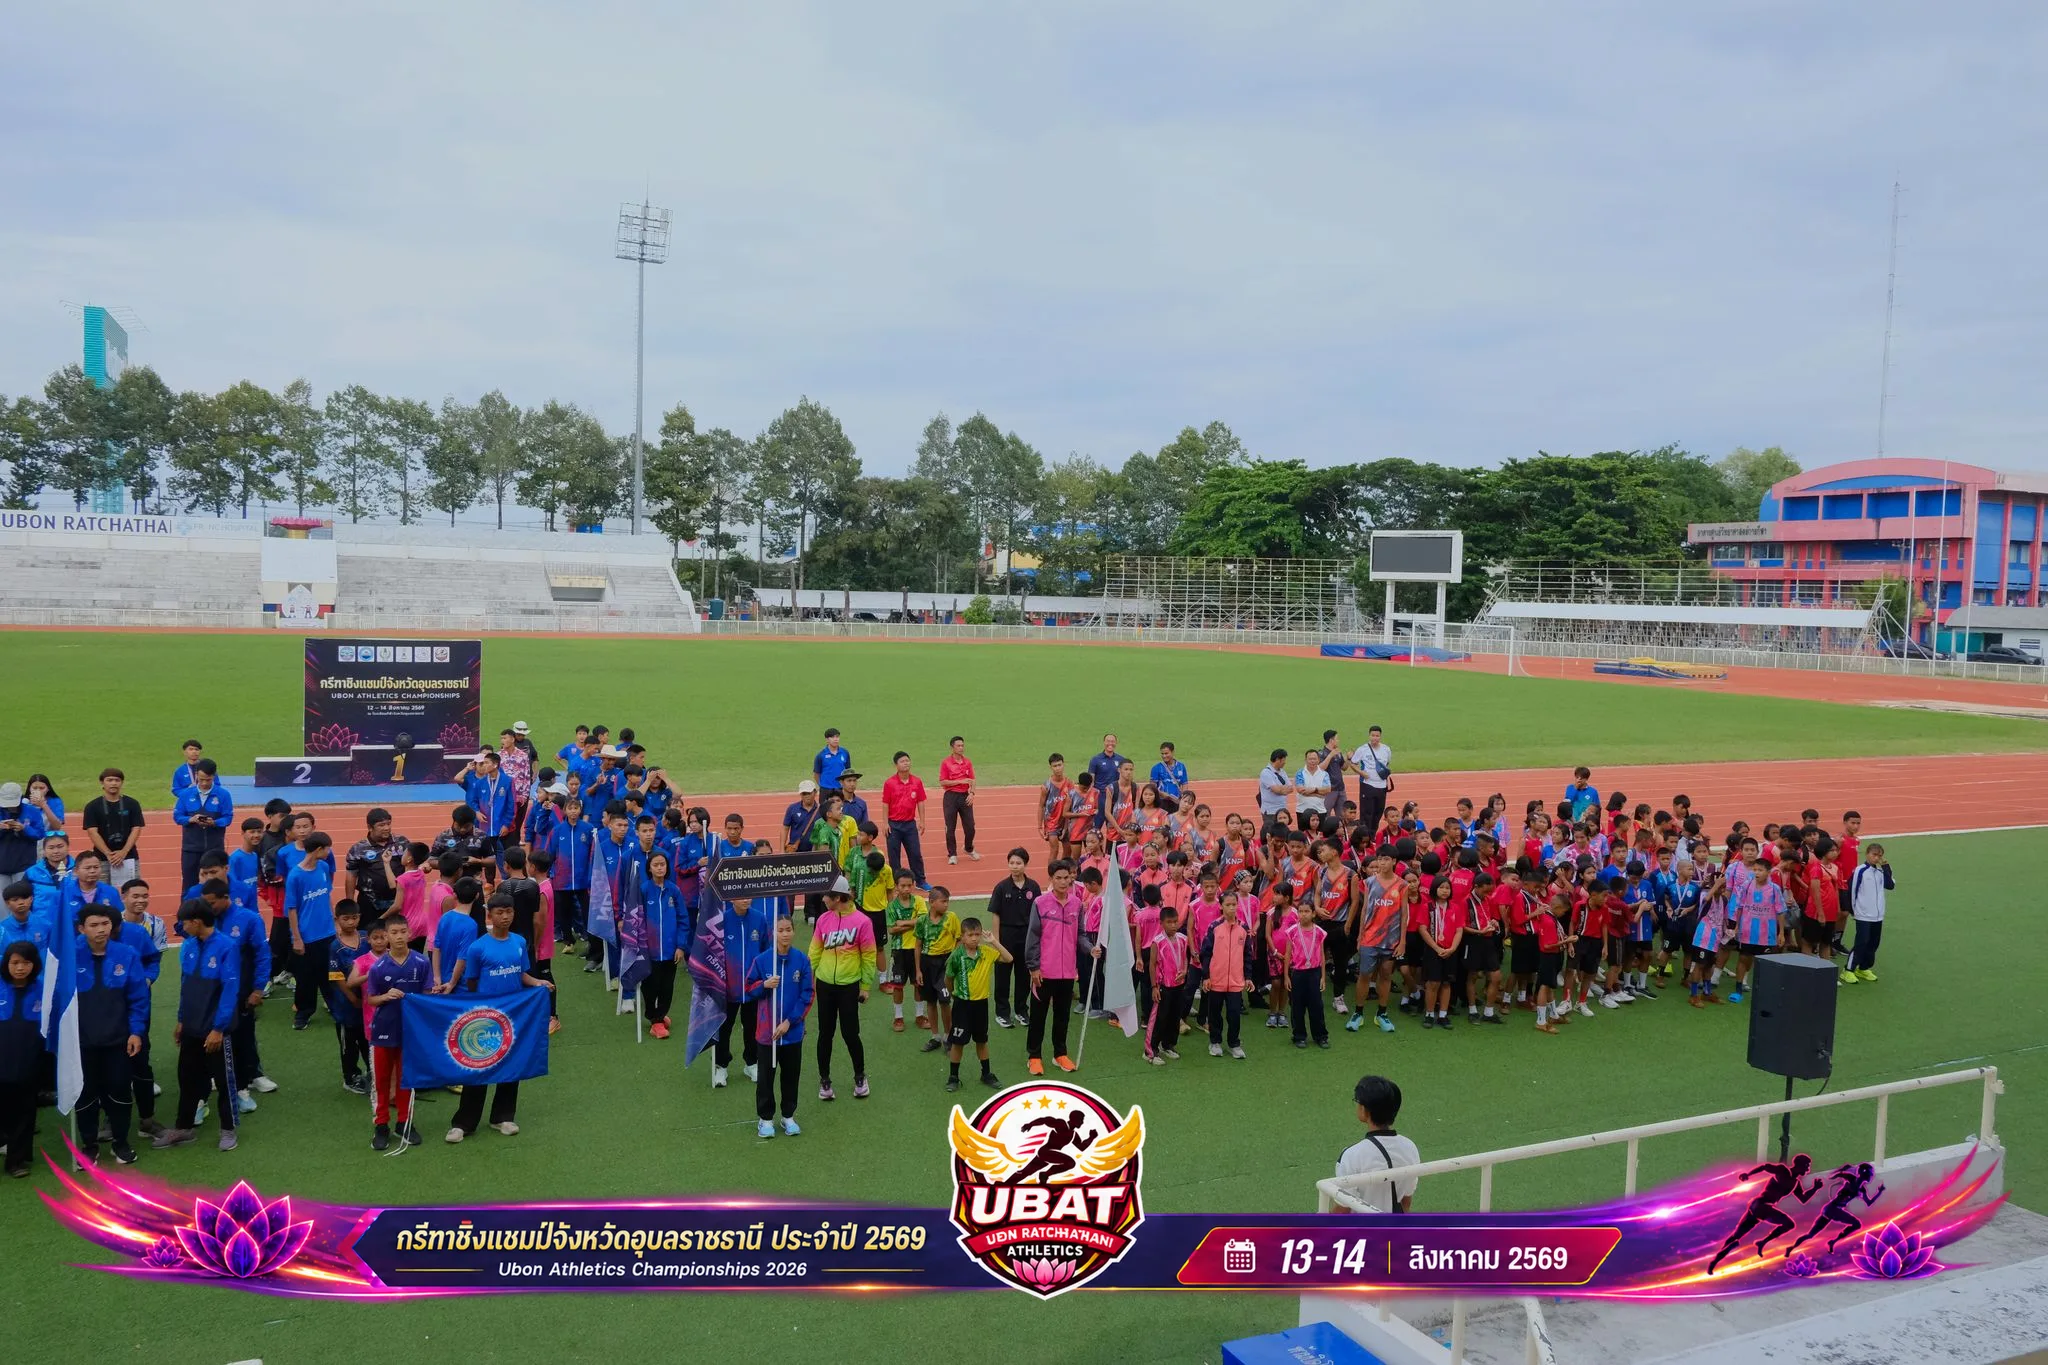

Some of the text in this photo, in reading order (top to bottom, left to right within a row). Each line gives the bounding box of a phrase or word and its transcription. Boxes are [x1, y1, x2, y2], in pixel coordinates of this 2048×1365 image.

[2, 513, 172, 534] UBON RATCHATHA
[390, 753, 407, 781] 1
[293, 763, 312, 784] 2
[1225, 857, 1243, 865] KNP
[744, 881, 779, 889] ATHLETICS
[781, 877, 829, 886] CHAMPIONSHIPS
[1374, 898, 1394, 906] KNP
[952, 1028, 964, 1037] 17
